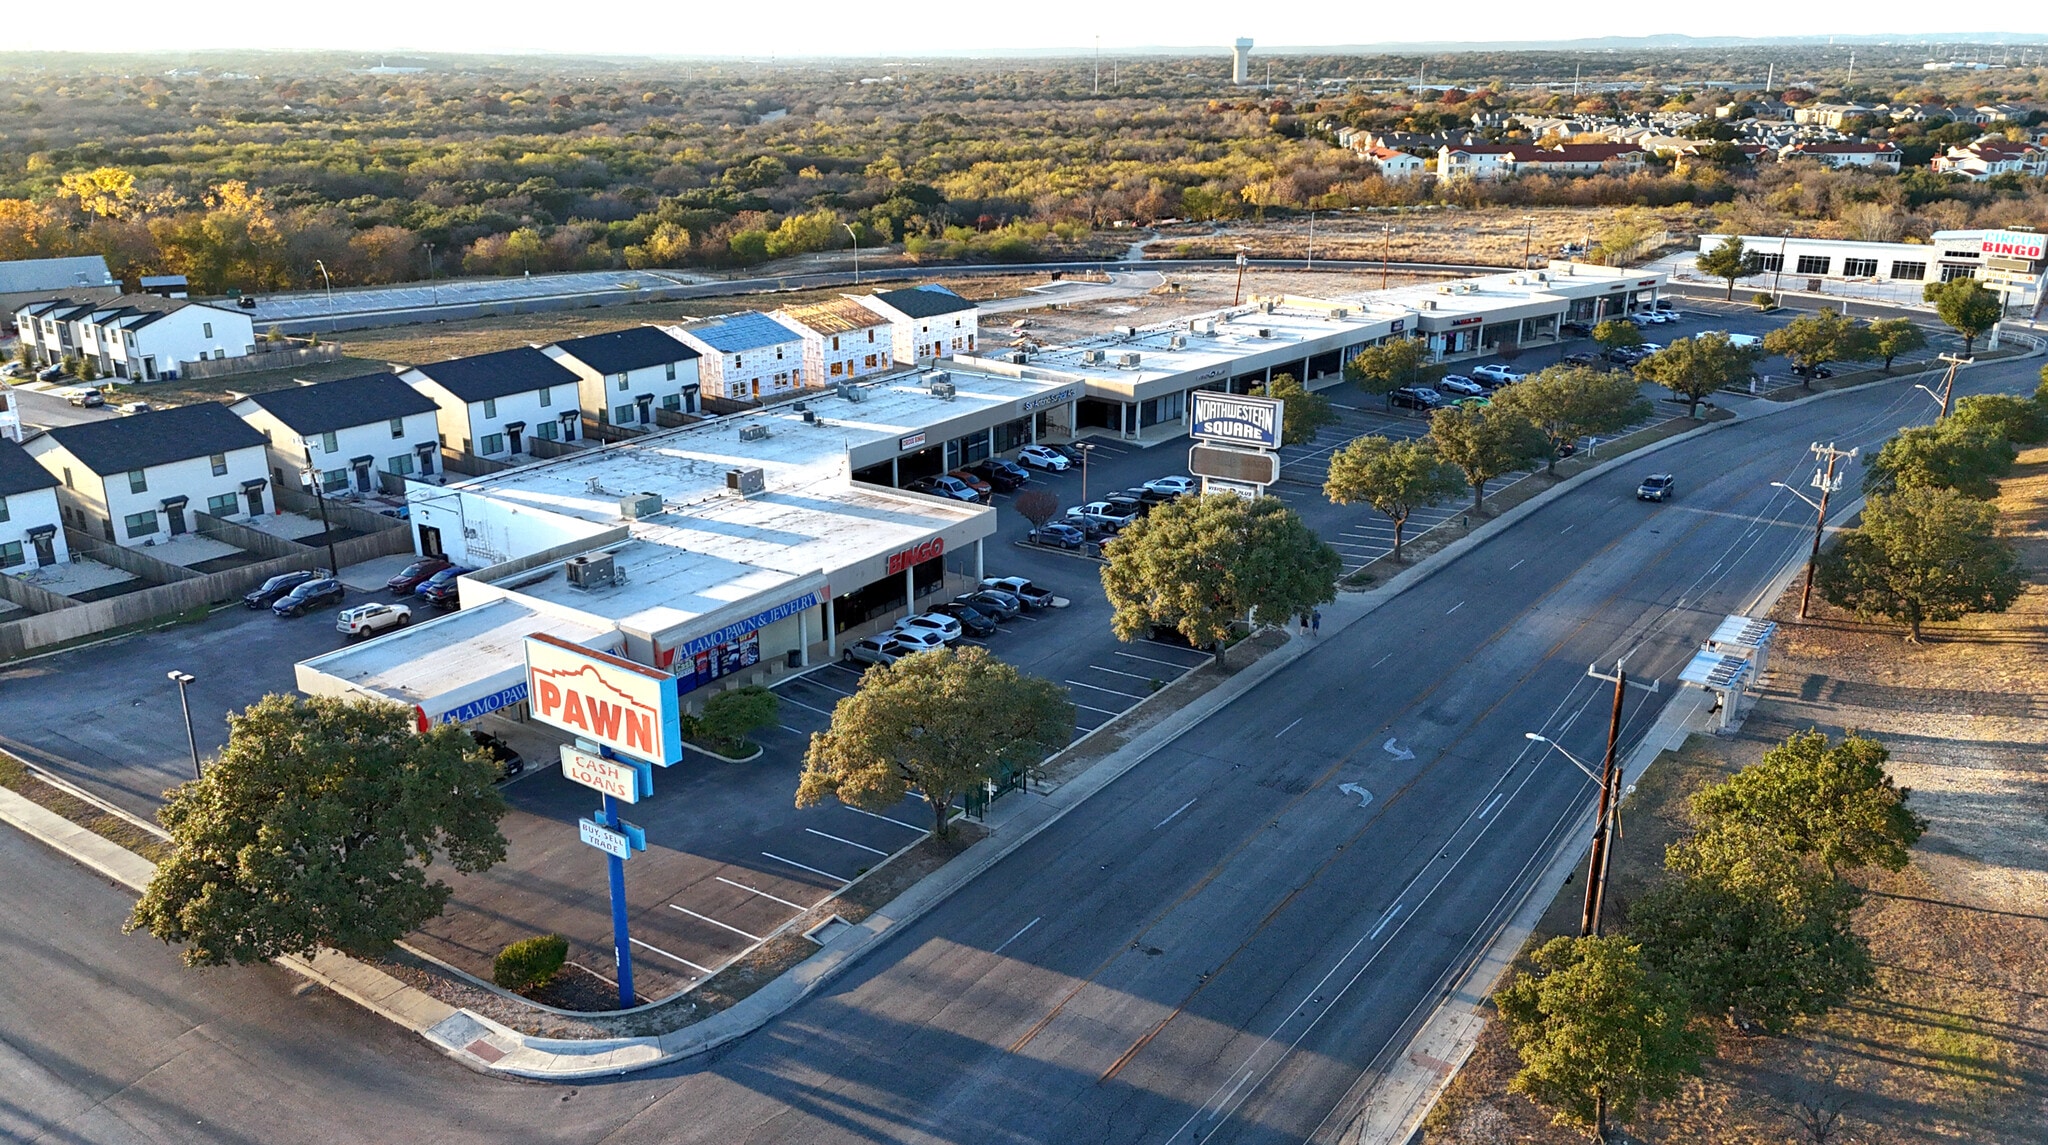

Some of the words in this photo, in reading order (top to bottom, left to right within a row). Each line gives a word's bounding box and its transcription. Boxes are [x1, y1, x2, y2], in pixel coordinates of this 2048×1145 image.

[1982, 242, 2040, 257] BINGO
[1985, 232, 2043, 247] CIRCUS
[1195, 400, 1274, 435] NORTHWESTERN
[1203, 420, 1263, 440] SQUARE
[888, 537, 944, 575] BINGO
[680, 630, 723, 660] ALAMO
[726, 615, 756, 640] PAWN
[757, 613, 768, 627] &
[769, 593, 815, 623] JEWELRY
[446, 694, 500, 724] ALAMO
[539, 678, 653, 754] PAWN
[575, 756, 619, 780] CASH
[572, 767, 626, 797] LOANS
[582, 823, 601, 838] BUY,
[603, 832, 624, 847] SELL
[588, 835, 619, 854] TRADE
